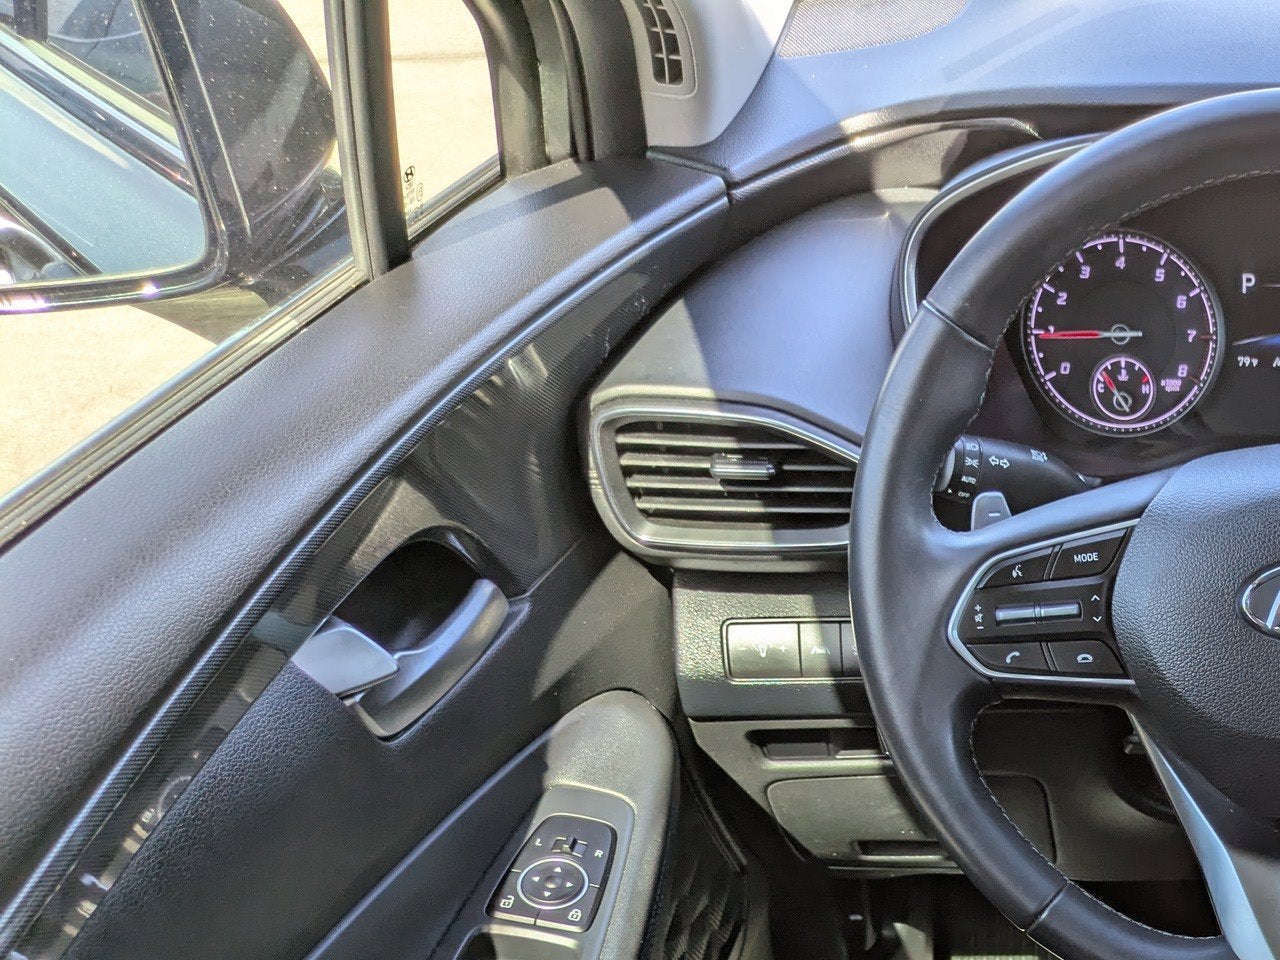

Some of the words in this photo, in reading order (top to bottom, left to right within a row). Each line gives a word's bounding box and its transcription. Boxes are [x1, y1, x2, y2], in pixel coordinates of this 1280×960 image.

[1115, 256, 1126, 269] 4
[1079, 265, 1091, 279] 3
[1154, 268, 1165, 282] 5
[1242, 273, 1256, 294] P
[1056, 291, 1068, 306] 2
[1176, 295, 1187, 309] 6
[1187, 329, 1197, 342] 7
[1177, 364, 1188, 377] 8
[1073, 552, 1099, 563] MODE
[535, 839, 542, 847] L
[594, 850, 603, 858] R
